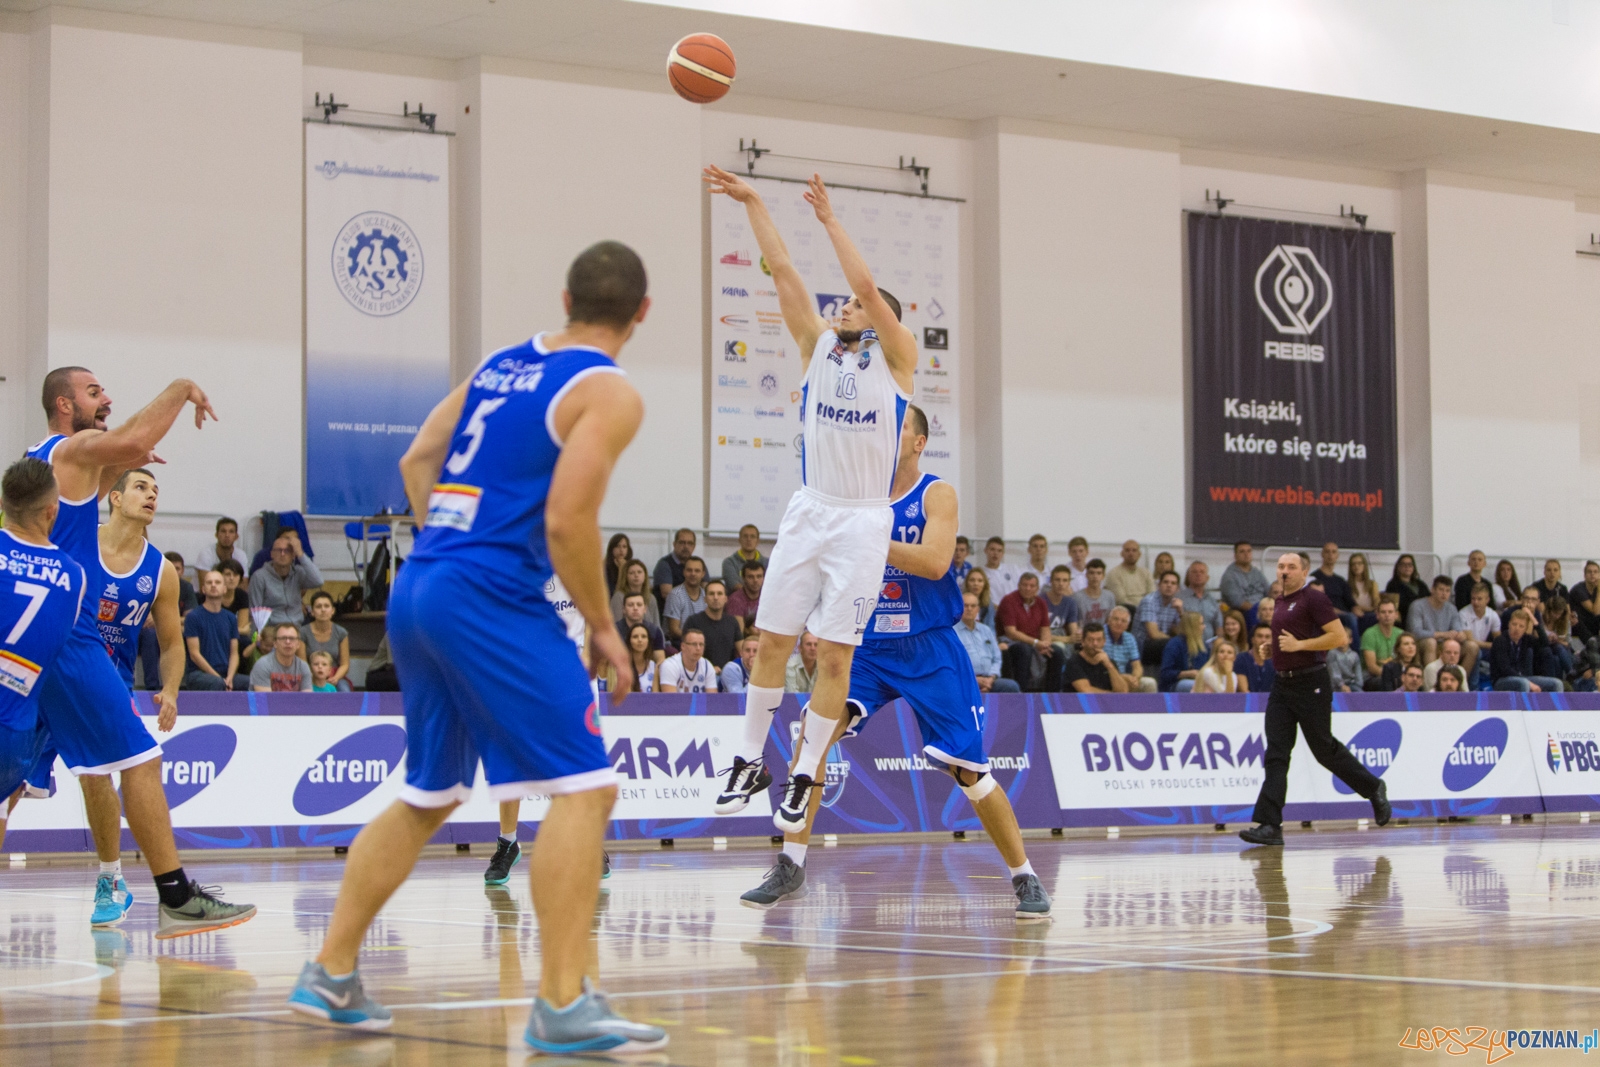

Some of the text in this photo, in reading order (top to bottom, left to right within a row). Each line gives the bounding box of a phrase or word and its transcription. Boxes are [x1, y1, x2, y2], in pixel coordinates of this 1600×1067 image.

[363, 216, 415, 250] UCZELNIANY
[1264, 341, 1325, 362] REBIS
[817, 402, 876, 424] BIOFARM
[1224, 398, 1302, 425] Książki,
[328, 421, 424, 435] www.azs.put.poznan.
[446, 397, 508, 475] 5
[923, 450, 950, 458] MARSH
[1224, 433, 1367, 463] które się czyta
[1209, 485, 1383, 512] www.rebis.com.pl
[898, 525, 922, 545] 12
[10, 549, 63, 569] GALERIA
[5, 580, 51, 646] 7
[120, 599, 150, 627] 20
[1557, 731, 1596, 741] fundacja
[1081, 731, 1266, 772] BIOFARM
[1350, 744, 1393, 767] trem
[1450, 742, 1499, 765] atrem
[1560, 741, 1600, 772] PBG
[161, 760, 216, 784] rem
[308, 754, 388, 783] atrem
[655, 784, 700, 799] LEKÓW
[1104, 775, 1259, 790] POLSKI PRODUCENT LEKÓW
